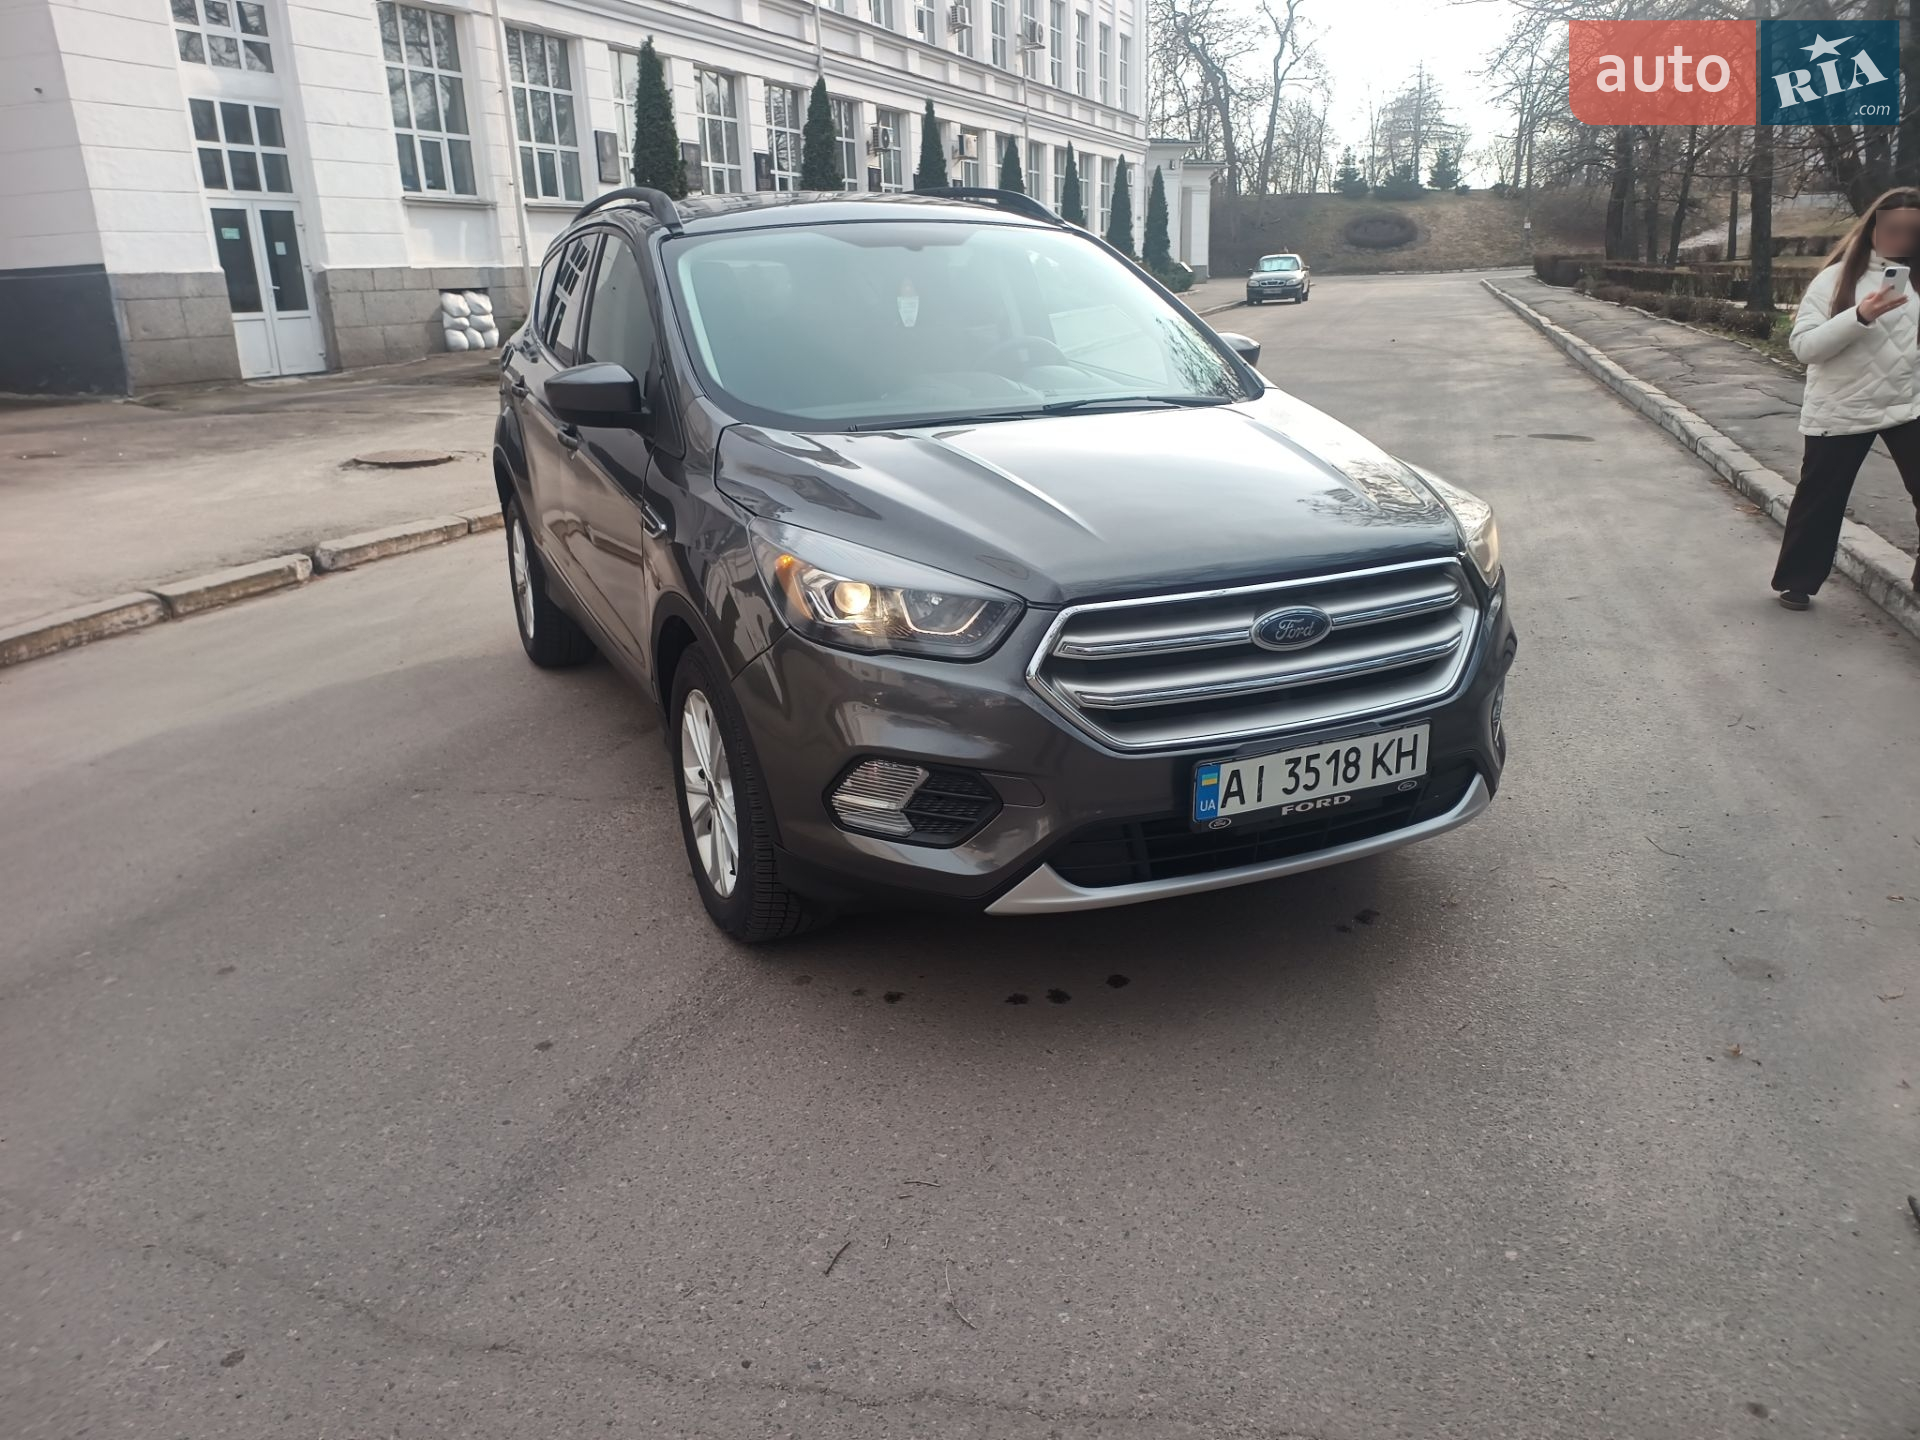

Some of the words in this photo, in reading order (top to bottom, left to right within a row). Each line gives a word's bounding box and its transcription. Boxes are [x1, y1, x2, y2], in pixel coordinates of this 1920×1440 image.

[1275, 618, 1315, 640] Ford
[1220, 765, 1264, 809] AI
[1282, 746, 1361, 795] 3518
[1371, 733, 1418, 780] KH
[1200, 799, 1216, 812] UA
[1281, 794, 1351, 816] FORD
